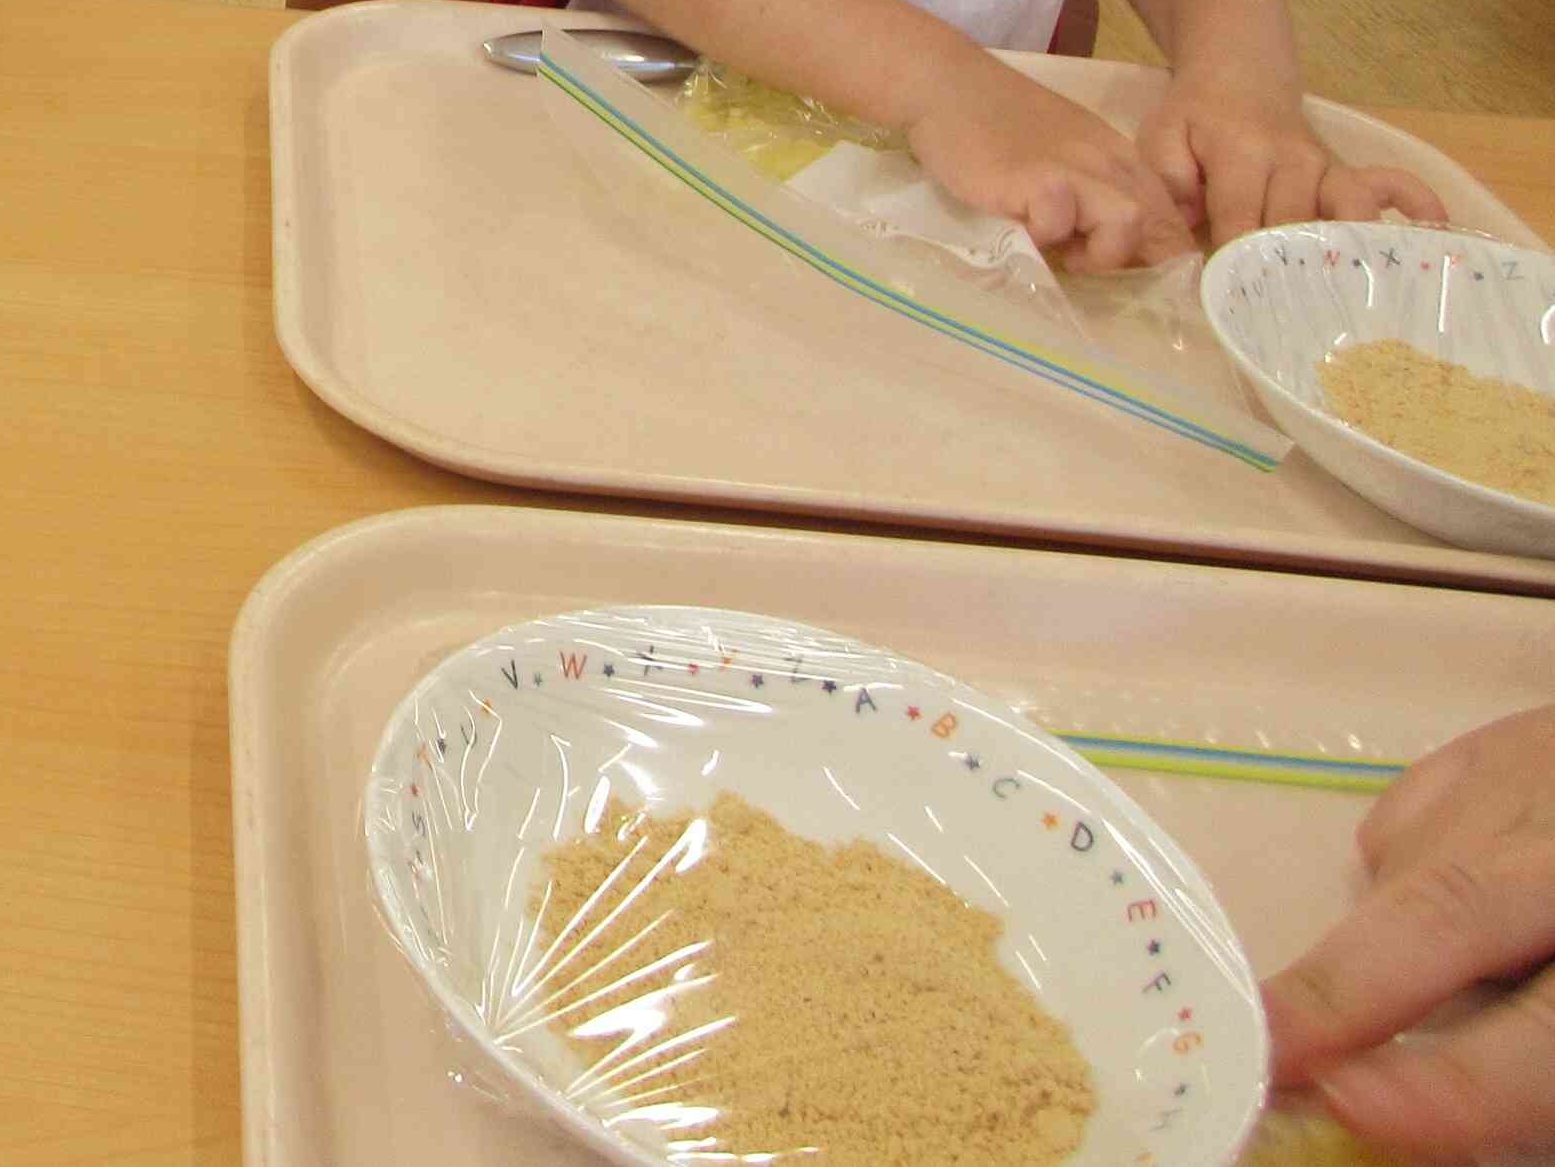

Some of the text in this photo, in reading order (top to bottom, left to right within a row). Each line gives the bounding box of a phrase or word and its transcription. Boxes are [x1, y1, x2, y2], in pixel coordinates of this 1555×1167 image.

[1379, 246, 1401, 268] X
[1501, 260, 1524, 282] Z
[501, 659, 519, 691] V
[559, 650, 588, 681] W
[854, 687, 878, 715] A
[930, 710, 959, 741] B
[992, 776, 1021, 801] C
[1069, 820, 1095, 853] D
[1125, 898, 1158, 923] E
[1140, 971, 1172, 996] F
